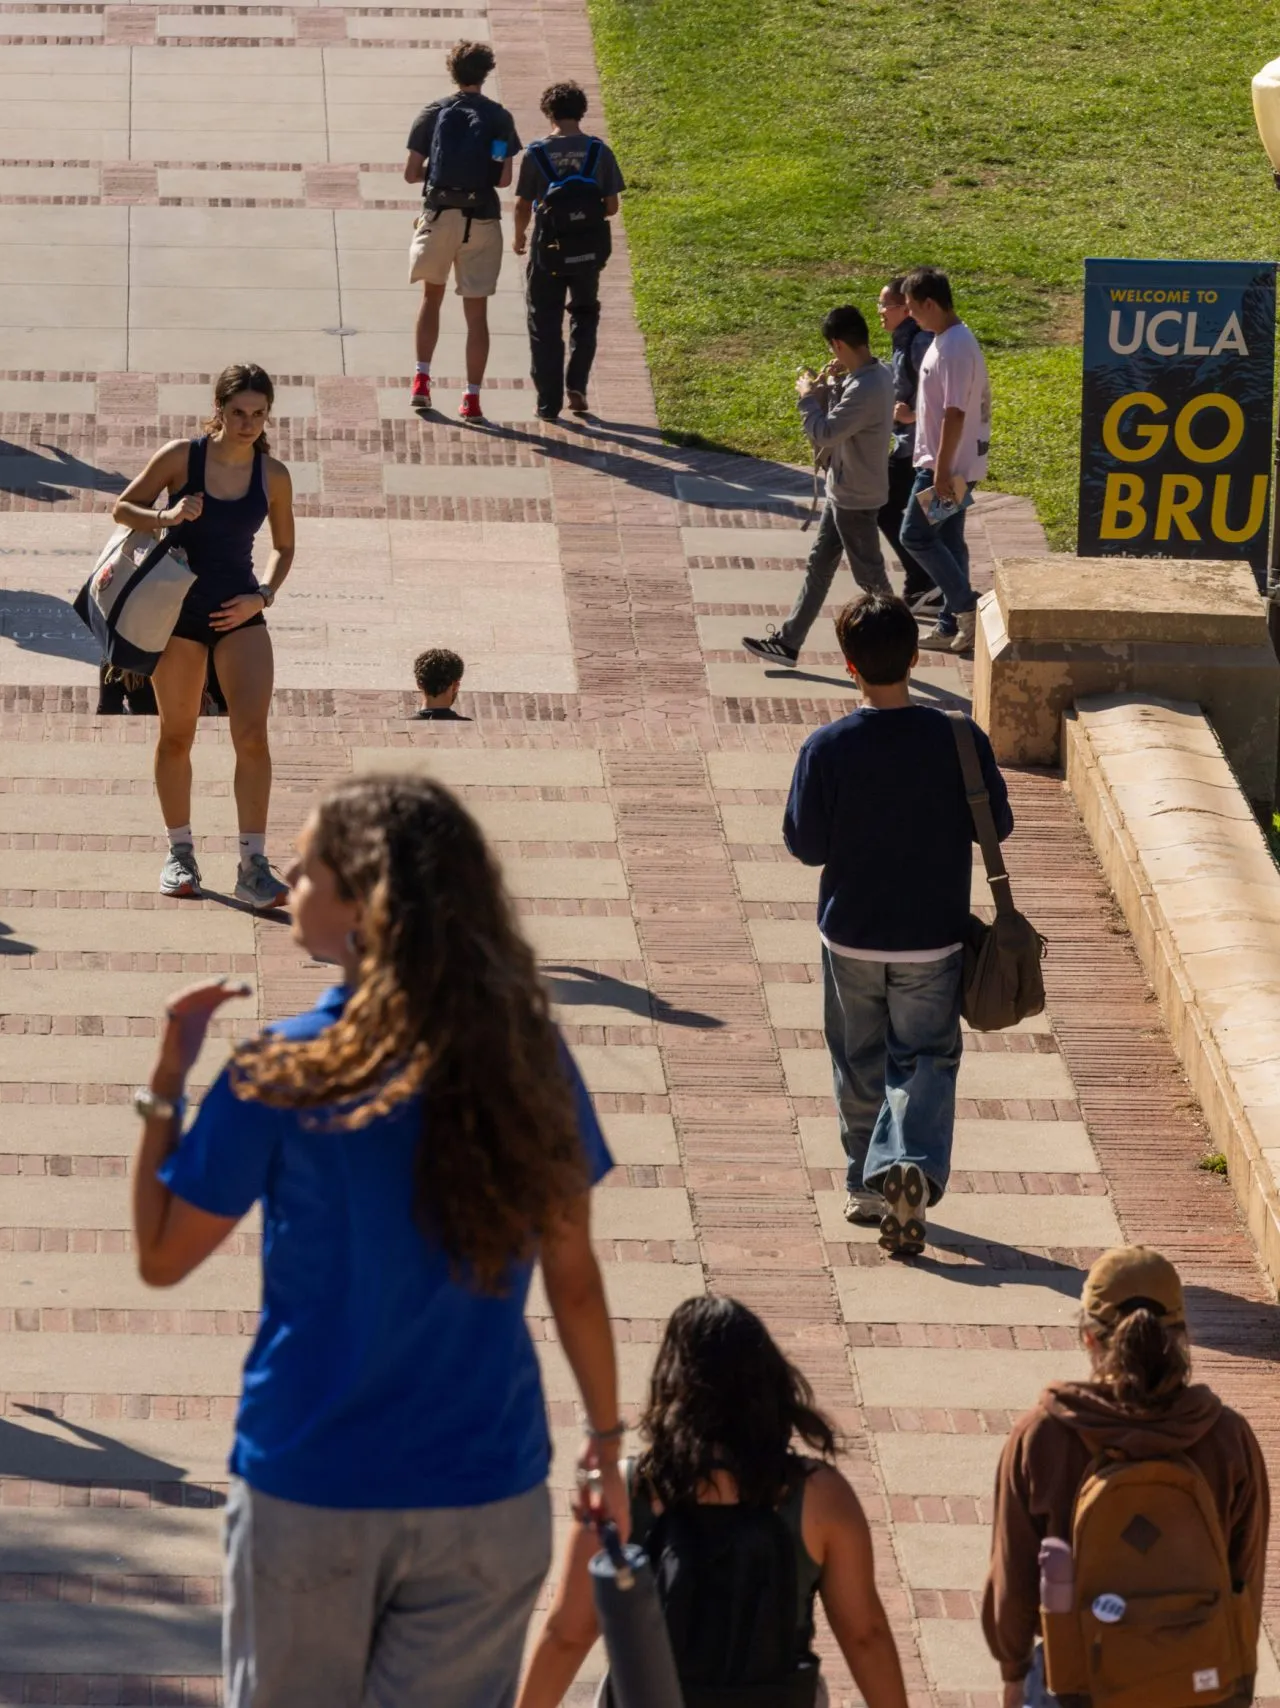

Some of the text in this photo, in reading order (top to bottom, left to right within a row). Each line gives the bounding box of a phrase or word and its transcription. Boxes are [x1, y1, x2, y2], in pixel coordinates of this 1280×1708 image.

[1109, 288, 1218, 304] WELCOME TO
[1108, 310, 1250, 356] UCLA
[1102, 391, 1245, 464] GO
[1099, 472, 1269, 543] BRU
